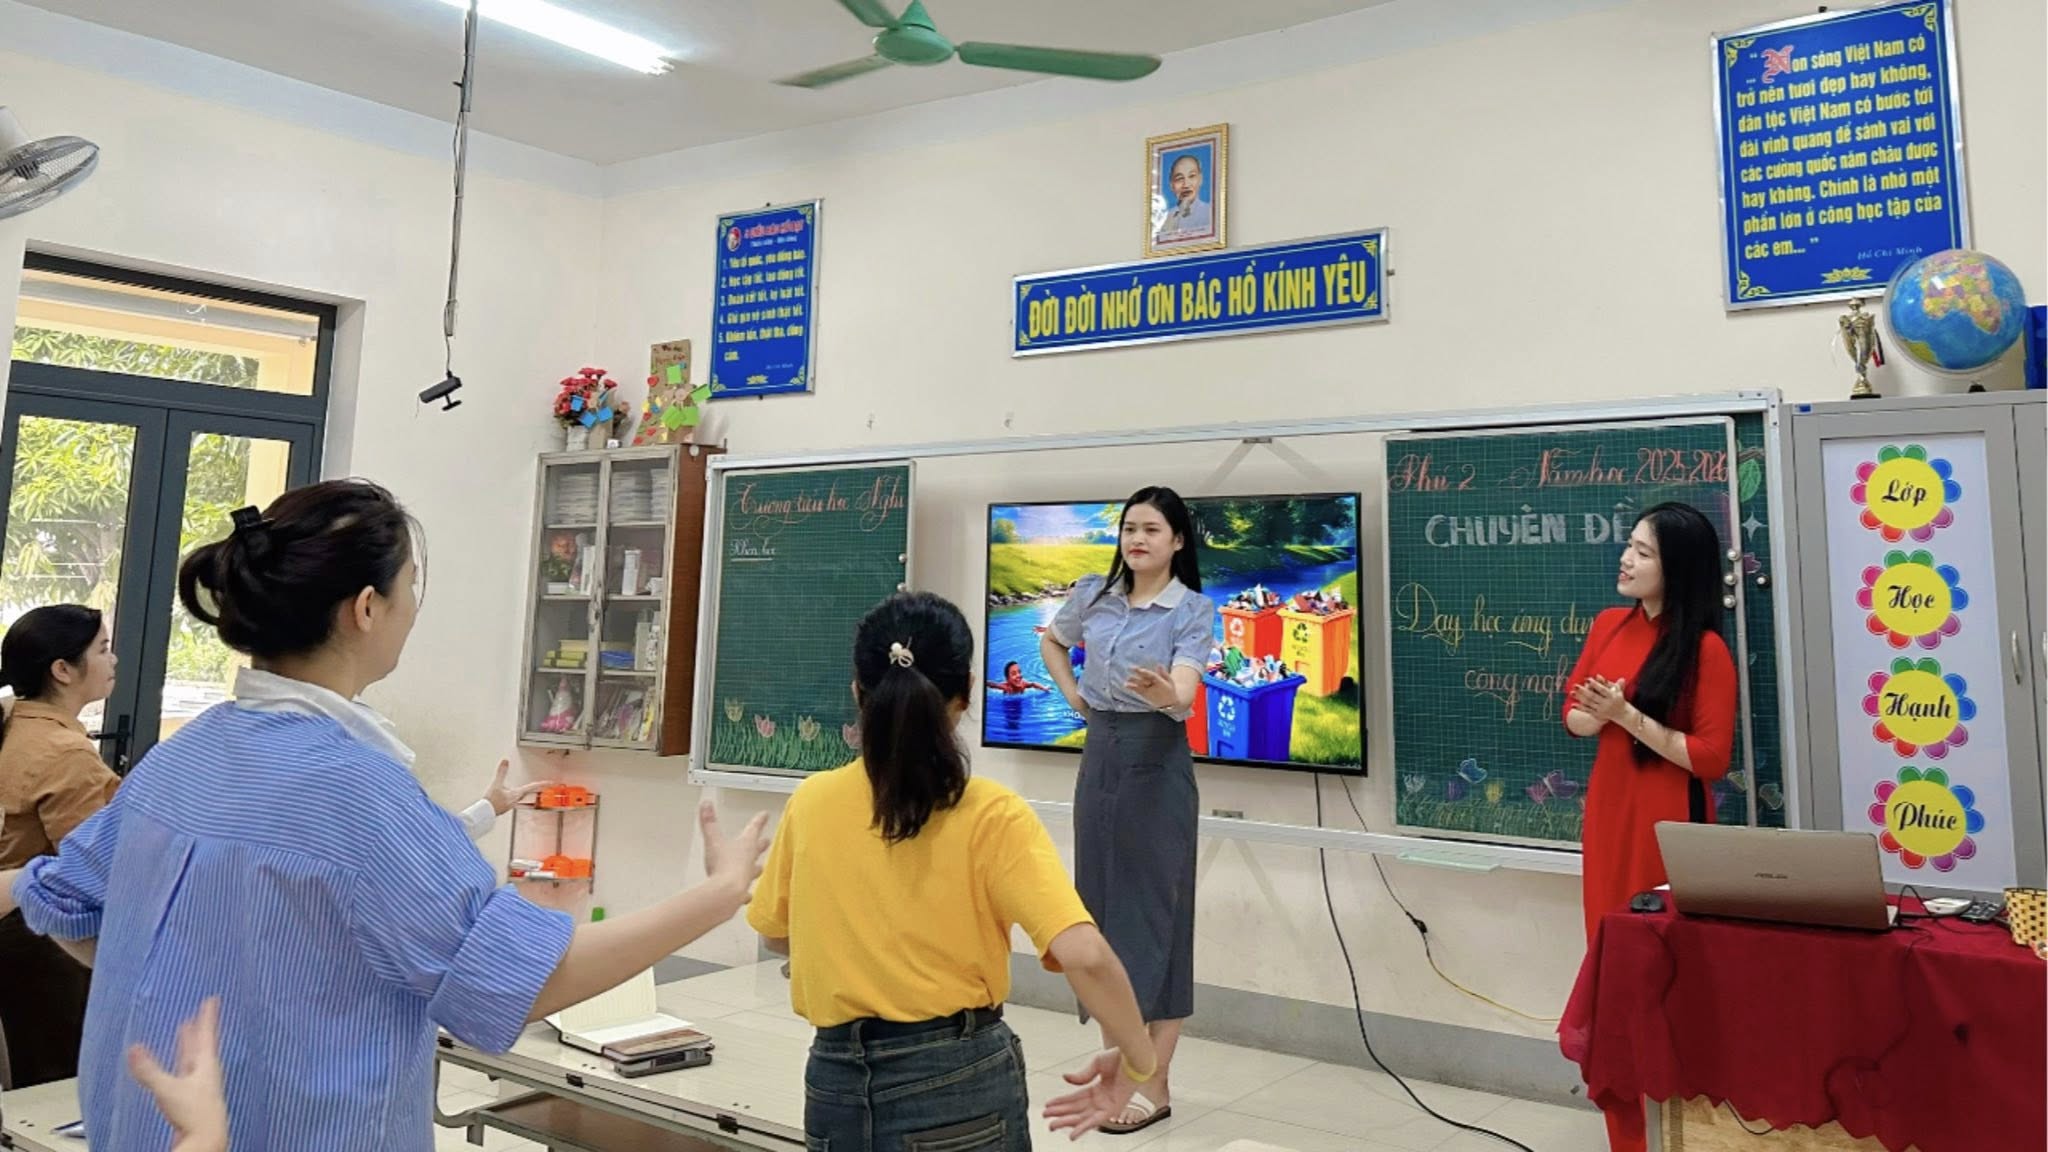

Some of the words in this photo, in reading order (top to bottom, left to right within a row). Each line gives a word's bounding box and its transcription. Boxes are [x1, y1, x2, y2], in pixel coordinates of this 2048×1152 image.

[1811, 50, 1842, 70] sông
[1845, 42, 1870, 65] Việt
[1874, 39, 1904, 59] Nam
[1908, 34, 1925, 52] có
[1736, 87, 1755, 108] trở
[1759, 86, 1785, 104] nên
[1788, 79, 1816, 99] tươi
[1820, 75, 1846, 97] đẹp
[1850, 71, 1876, 90] hay
[1738, 114, 1762, 133] dân
[1766, 111, 1786, 132] tộc
[1790, 105, 1816, 127] Việt
[1819, 101, 1851, 121] Nam
[1855, 95, 1872, 114] có
[1875, 91, 1910, 112] bước
[1914, 86, 1934, 106] tới
[1739, 138, 1759, 157] đài
[1762, 136, 1789, 155] vinh
[1792, 132, 1832, 152] quang
[1836, 121, 1852, 142] để
[1855, 120, 1887, 141] sánh
[1891, 116, 1911, 134] vai
[1915, 112, 1936, 132] với
[1740, 164, 1763, 183] các
[1766, 158, 1803, 180] cường
[1806, 151, 1837, 176] quốc
[1840, 152, 1867, 169] năm
[1871, 145, 1902, 165] châu
[1906, 141, 1938, 162] được
[1742, 190, 1766, 208] hay
[1769, 184, 1816, 204] không.
[1819, 177, 1859, 198] Chính
[1863, 174, 1877, 193] là
[1880, 167, 1907, 189] nhờ
[1912, 165, 1940, 188] một
[1743, 210, 1777, 236] phần
[1780, 209, 1802, 229] lớn
[1805, 206, 1814, 226] ở
[1818, 205, 1853, 225] công
[1856, 201, 1883, 223] học
[1887, 196, 1911, 220] tập
[1915, 190, 1942, 212] của
[1744, 239, 1769, 259] các
[1029, 288, 1060, 338] ĐỜI
[1064, 284, 1096, 335] ĐỜI
[1102, 276, 1142, 329] NHỚ
[1148, 283, 1175, 326] ƠN
[1181, 267, 1222, 322] BÁC
[1228, 259, 1257, 317] HỒ
[1263, 260, 1316, 313] KÍNH
[1322, 253, 1366, 306] YÊU
[1456, 463, 1478, 491] 2
[1882, 478, 1927, 508] Lớp
[1425, 503, 1566, 547] CHUYÊN
[1471, 594, 1504, 639] học
[1887, 585, 1935, 614] Học
[1884, 692, 1952, 722] Hạnh
[1892, 801, 1959, 831] Phúc
